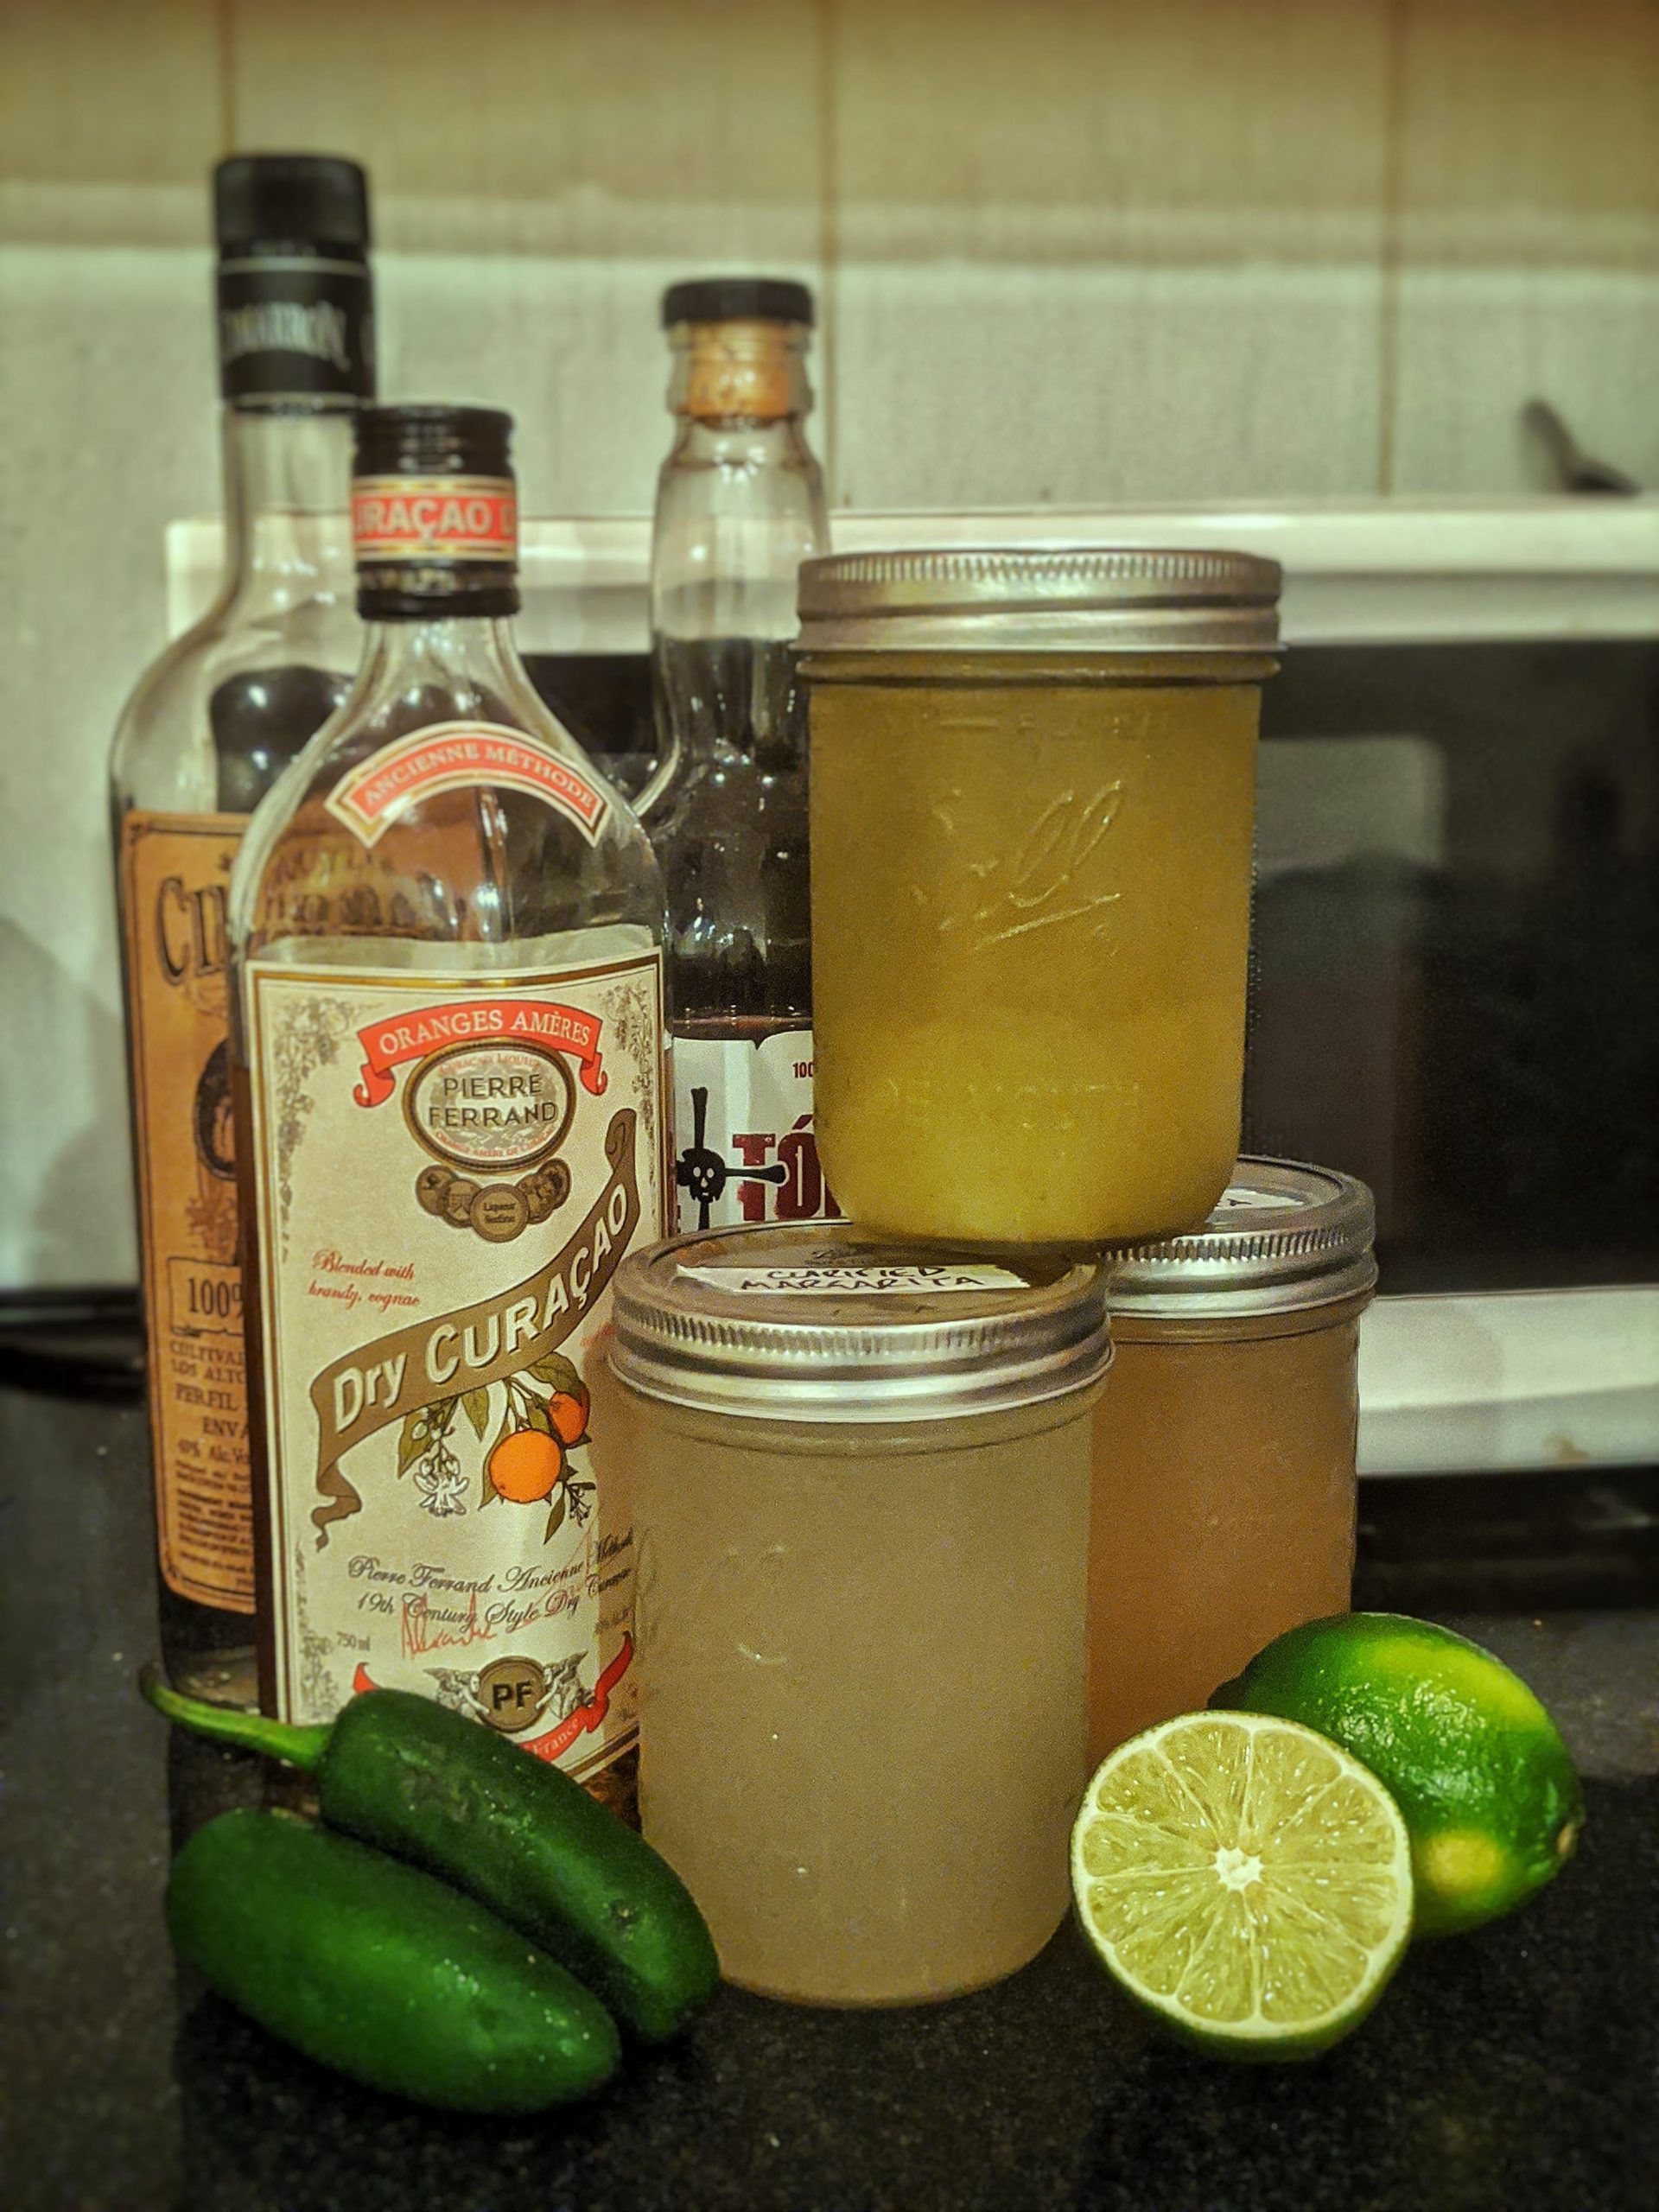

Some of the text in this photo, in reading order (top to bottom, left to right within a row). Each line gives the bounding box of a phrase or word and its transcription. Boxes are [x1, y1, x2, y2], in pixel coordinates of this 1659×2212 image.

[364, 743, 595, 808] ANCIENNE MÉTHODE
[378, 1009, 591, 1055] ORANGES AMÈRES
[443, 1074, 543, 1097] PIERRE
[429, 1102, 557, 1127] FERRAND
[733, 1115, 842, 1221] TÓ
[312, 1249, 415, 1280] Blended with
[741, 1276, 985, 1290] MARGARITA
[334, 1184, 628, 1433] Dry CURAÇAO
[368, 1293, 420, 1313] cognac
[175, 1382, 238, 1412] PERFIL
[347, 1555, 406, 1585] Pierre
[409, 1563, 496, 1593] Ferrand
[497, 1565, 584, 1592] Ancienne
[358, 1592, 394, 1615] 19th
[402, 1592, 478, 1633] Century
[485, 1599, 540, 1633] Style
[336, 1631, 356, 1649] 750
[493, 1680, 532, 1711] PF
